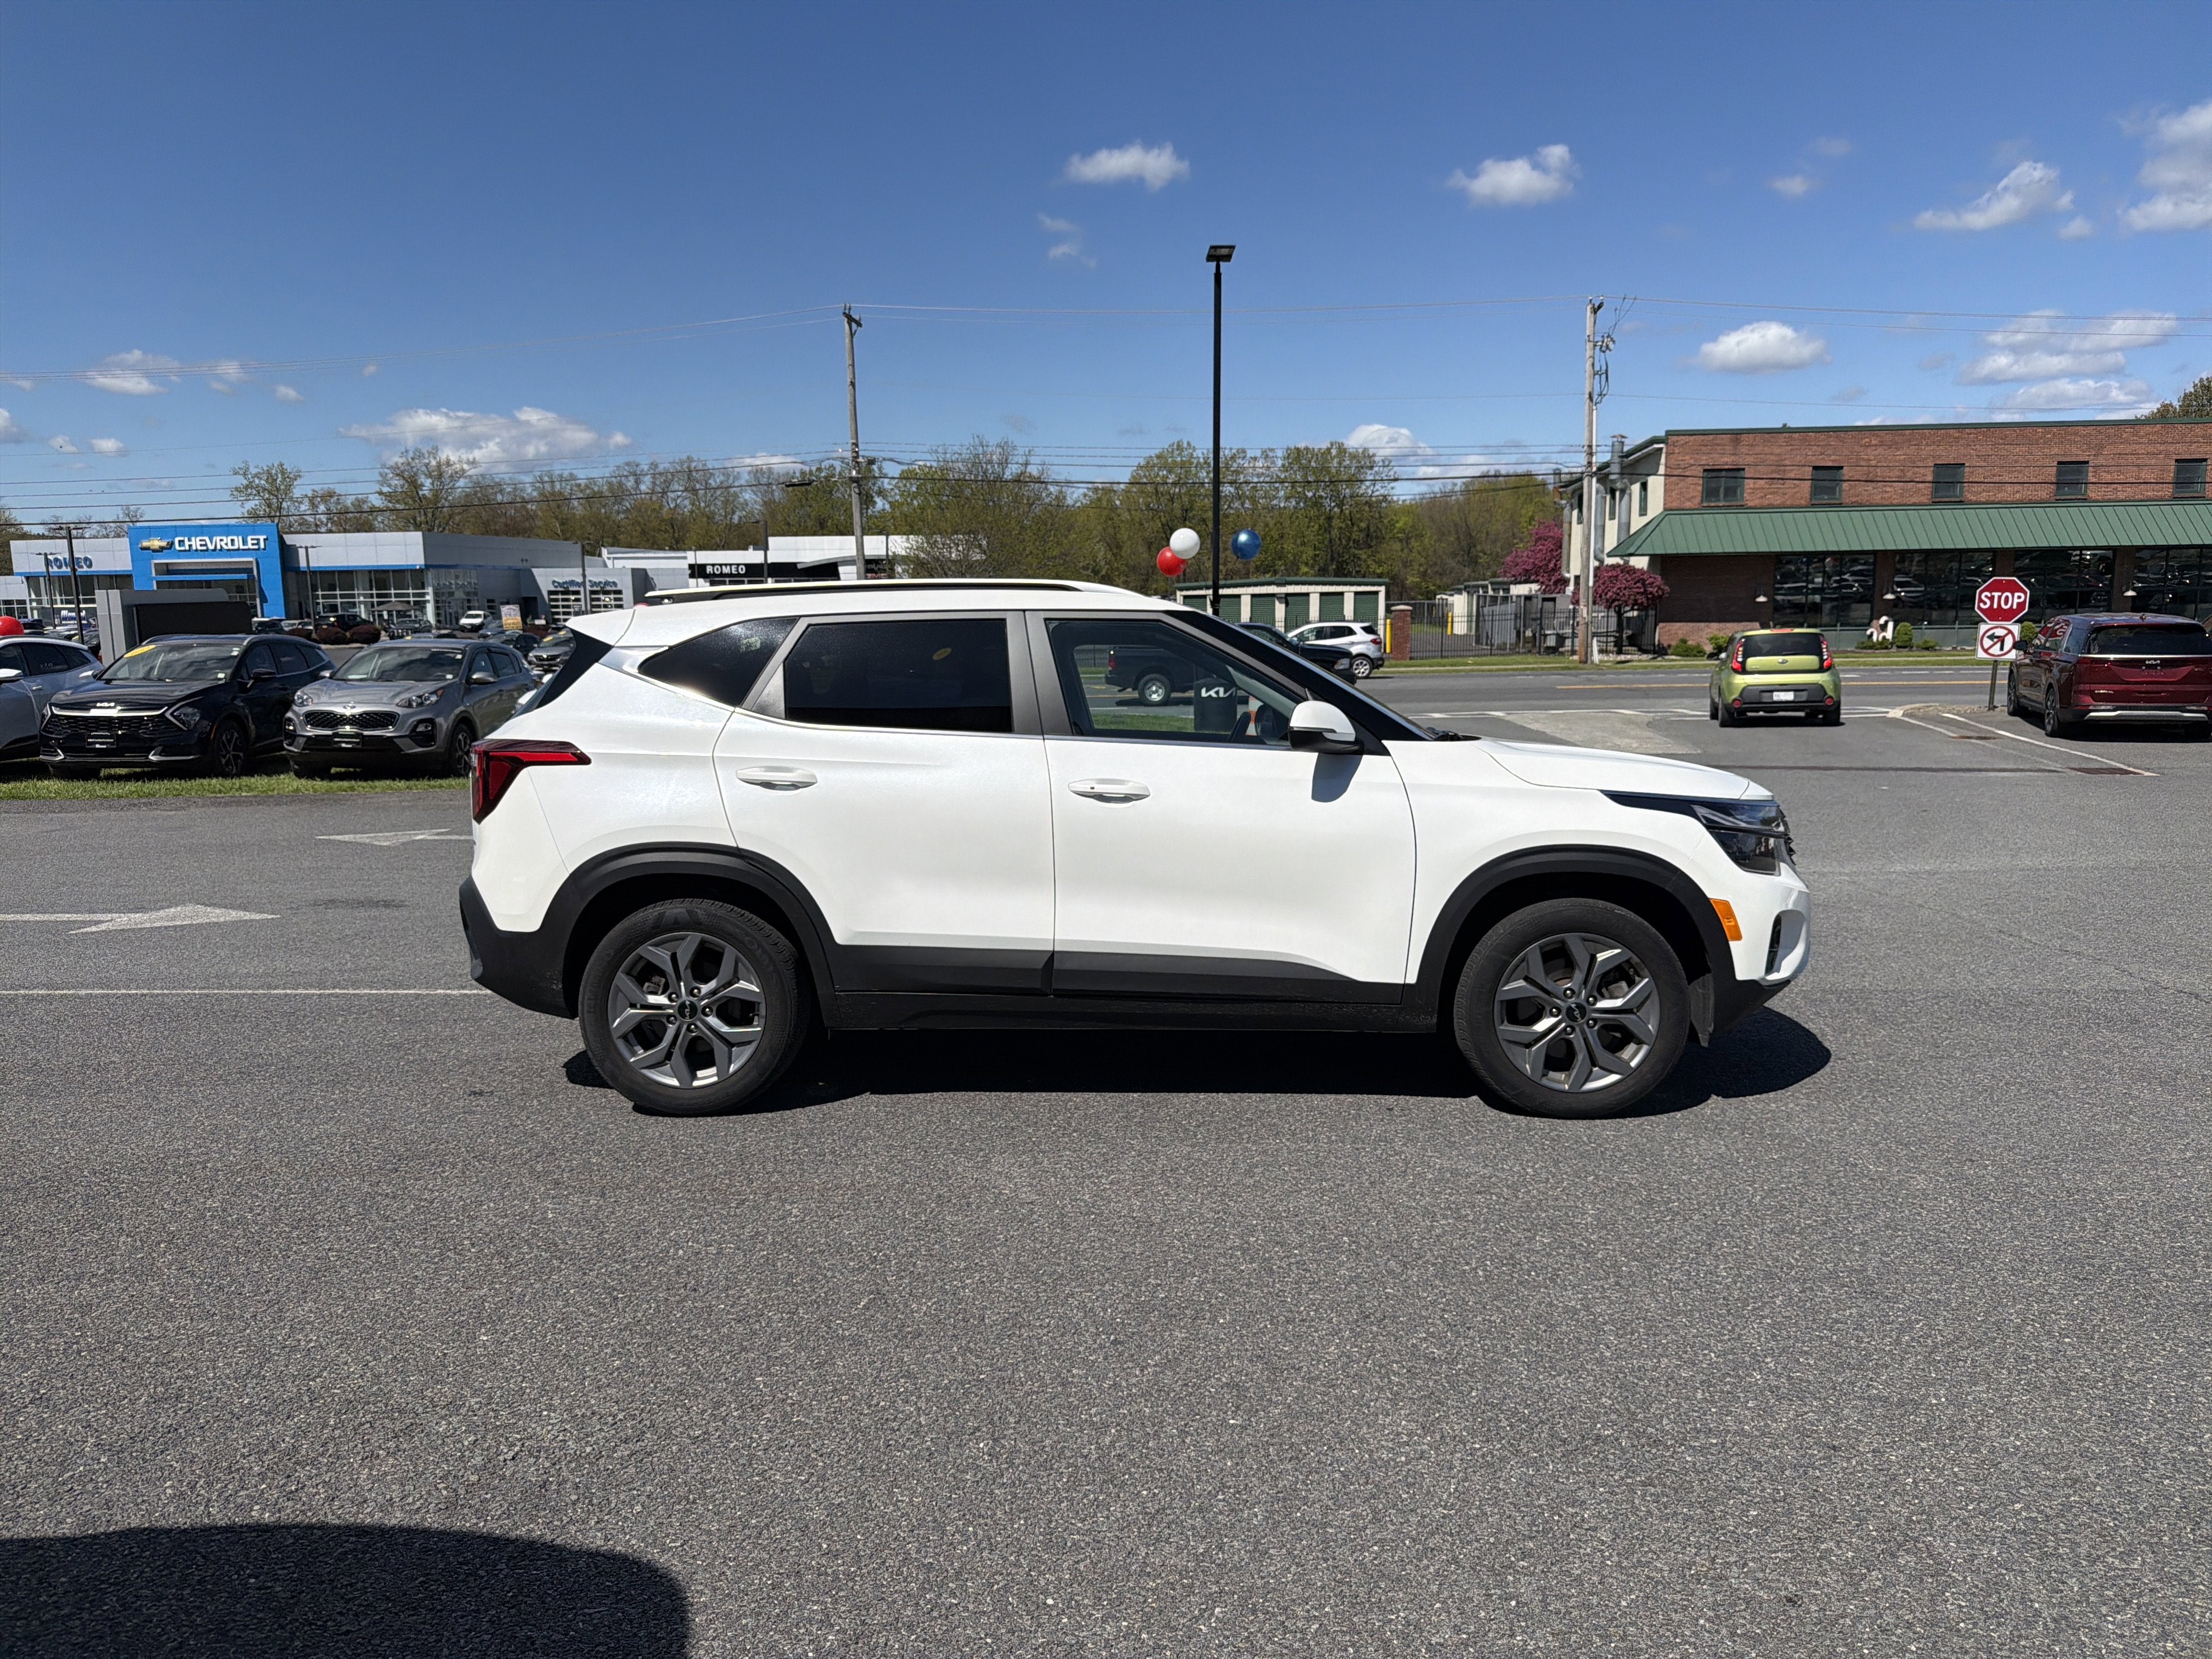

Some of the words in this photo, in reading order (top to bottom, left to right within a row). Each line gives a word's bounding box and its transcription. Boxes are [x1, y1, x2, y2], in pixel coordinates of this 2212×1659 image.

[175, 535, 267, 550] CHEVROLET
[706, 565, 746, 574] ROMEO
[1979, 592, 2024, 609] STOP
